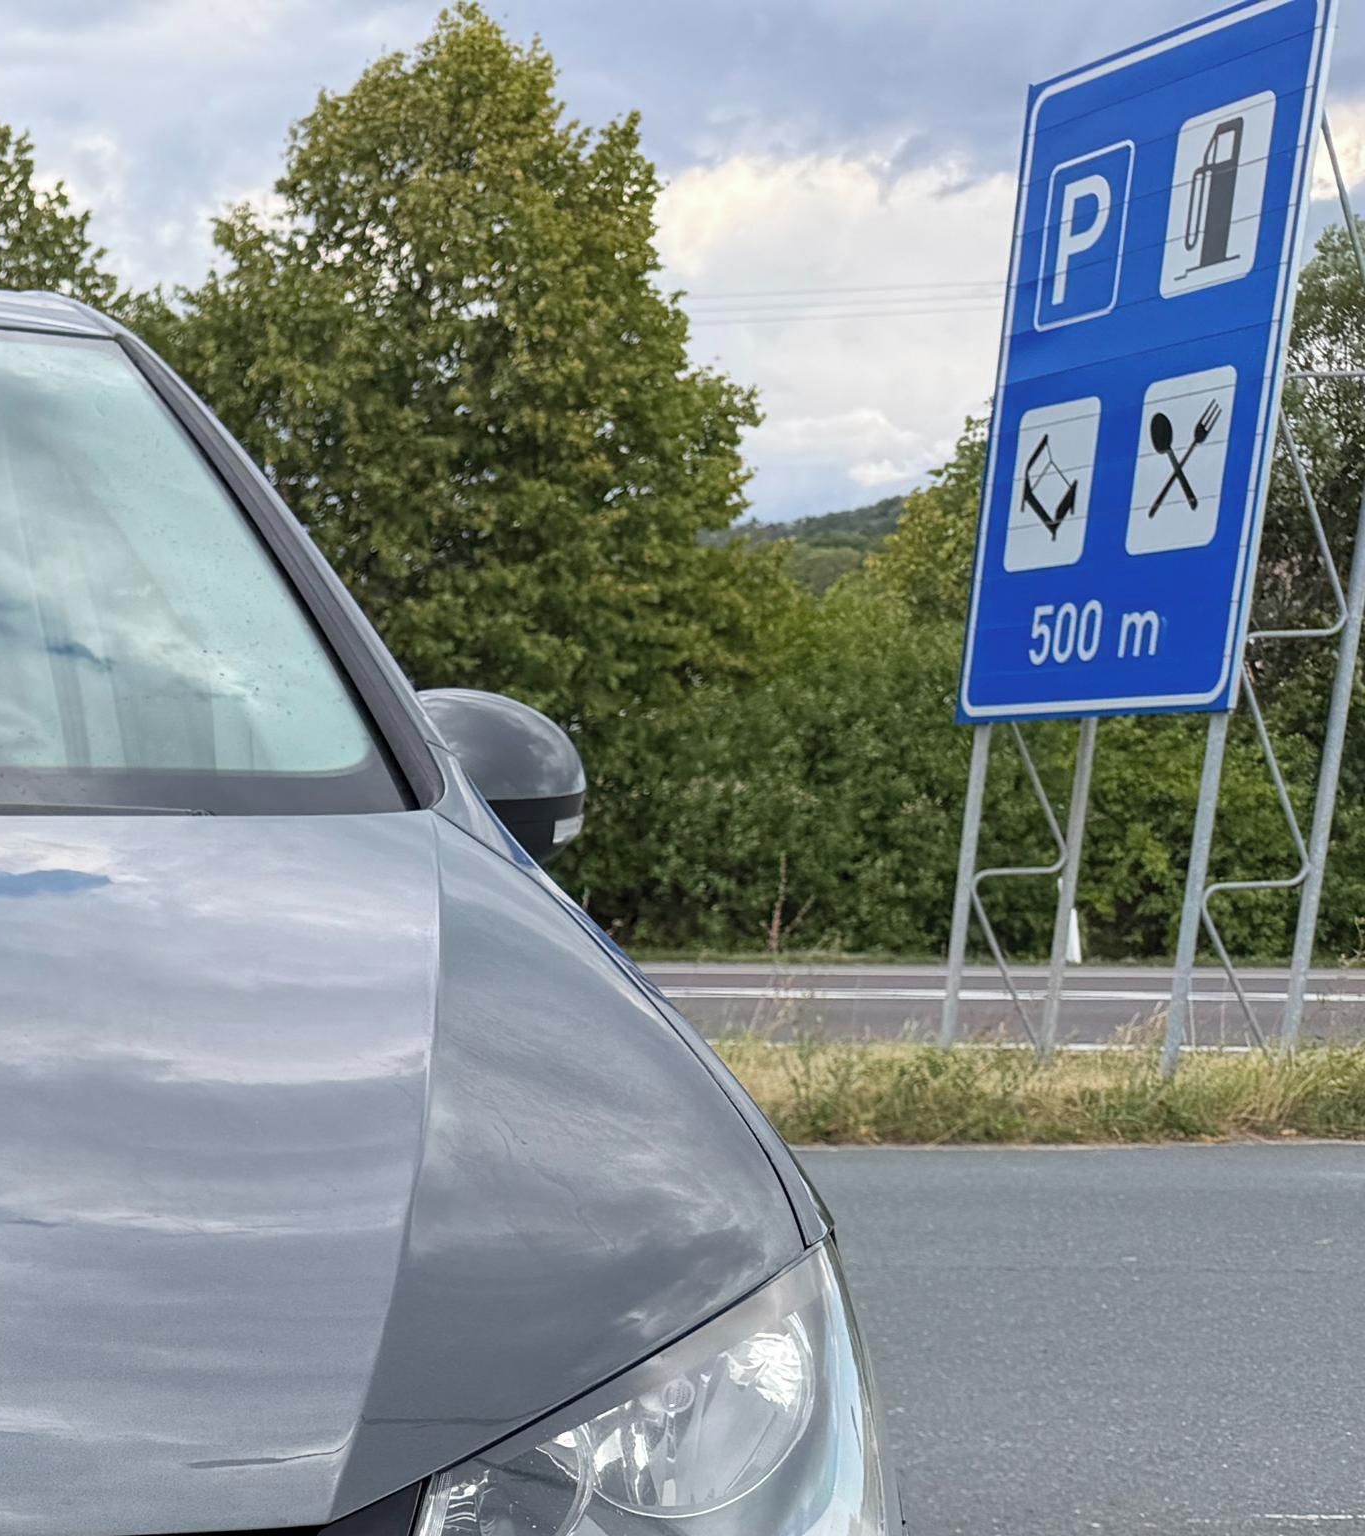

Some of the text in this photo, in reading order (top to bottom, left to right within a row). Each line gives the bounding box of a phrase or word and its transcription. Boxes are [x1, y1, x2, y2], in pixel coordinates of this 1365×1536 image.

[1051, 174, 1112, 306] P
[1028, 599, 1159, 666] 500 m
